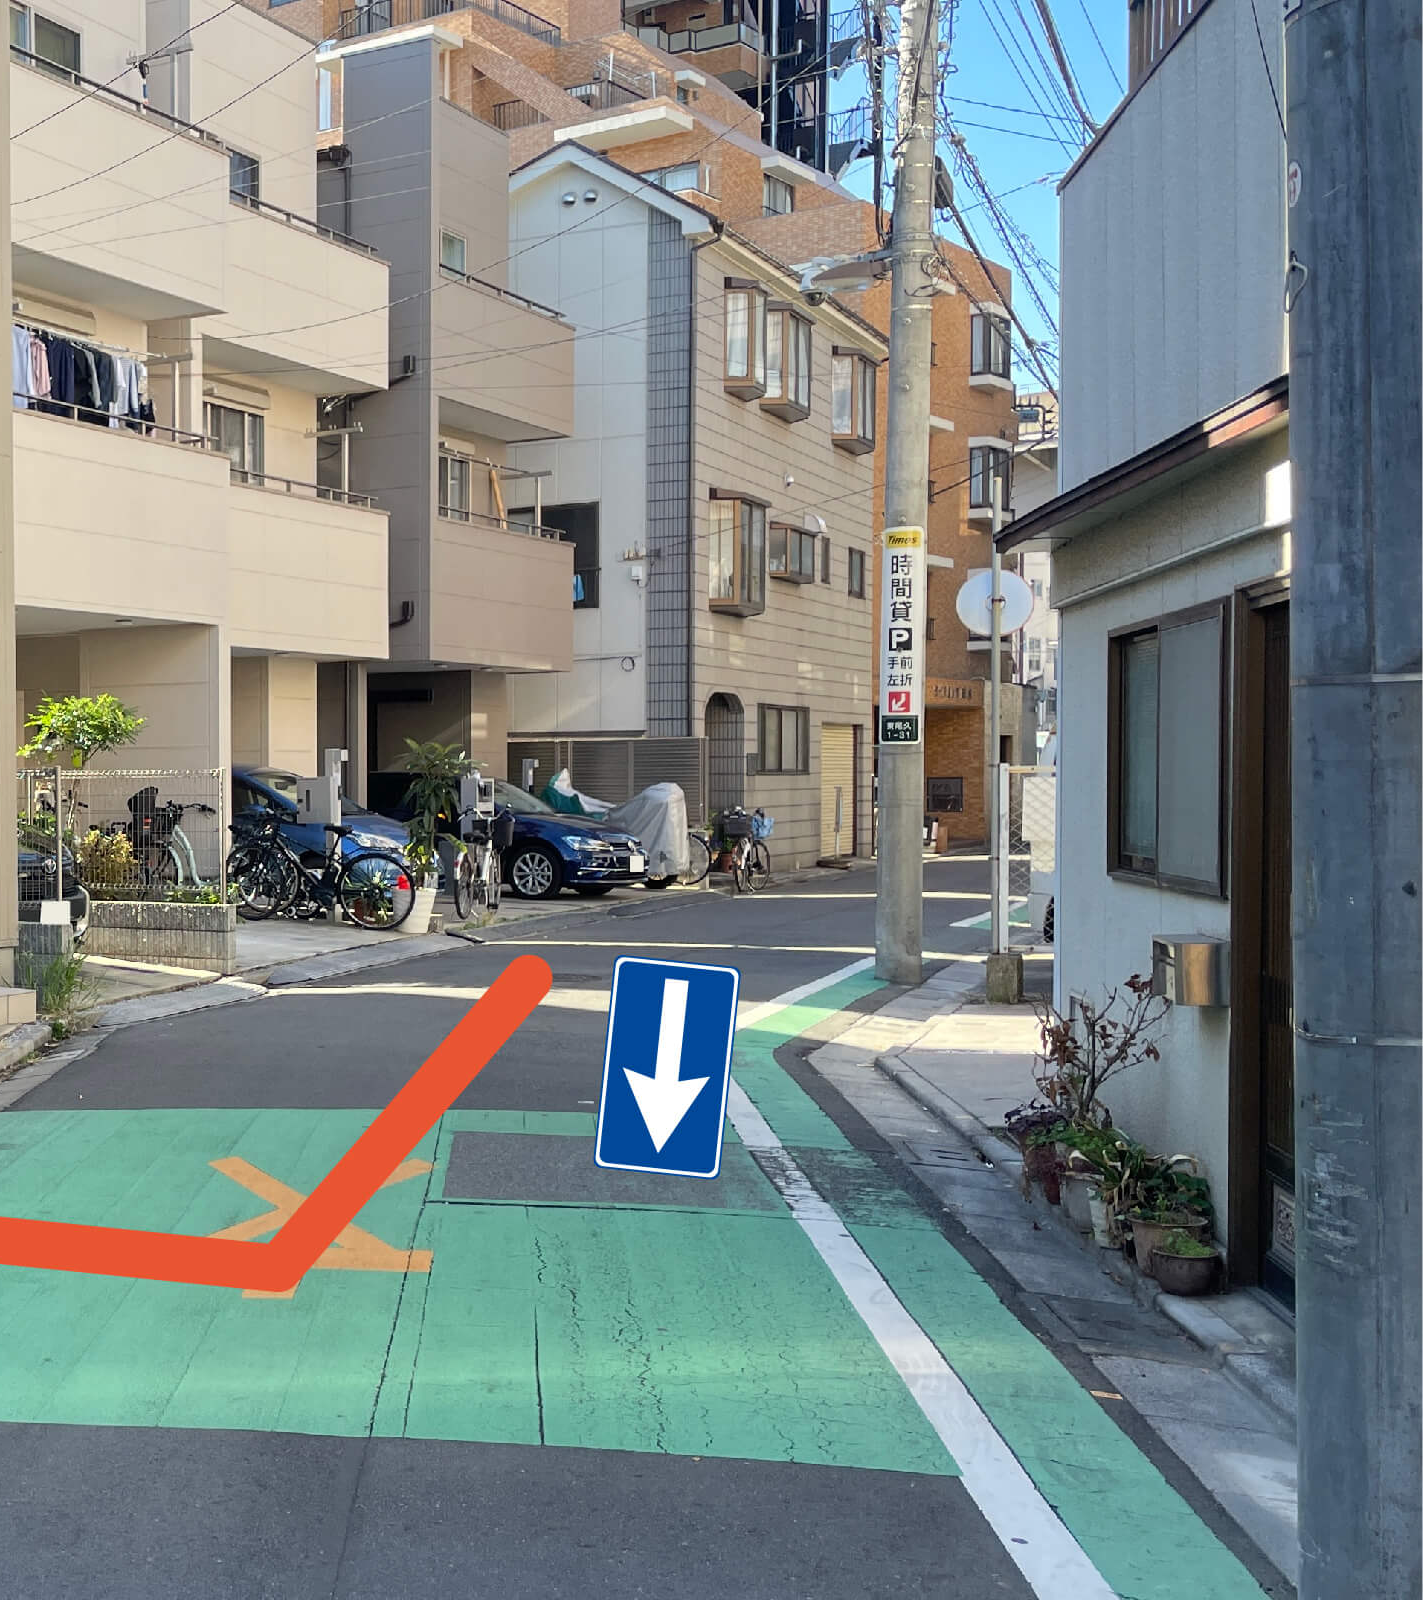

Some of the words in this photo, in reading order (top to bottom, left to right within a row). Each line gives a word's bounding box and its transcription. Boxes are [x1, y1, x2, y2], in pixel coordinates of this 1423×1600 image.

[890, 554, 913, 623] 時間貸
[888, 656, 913, 669] 手前
[887, 674, 913, 686] 左折
